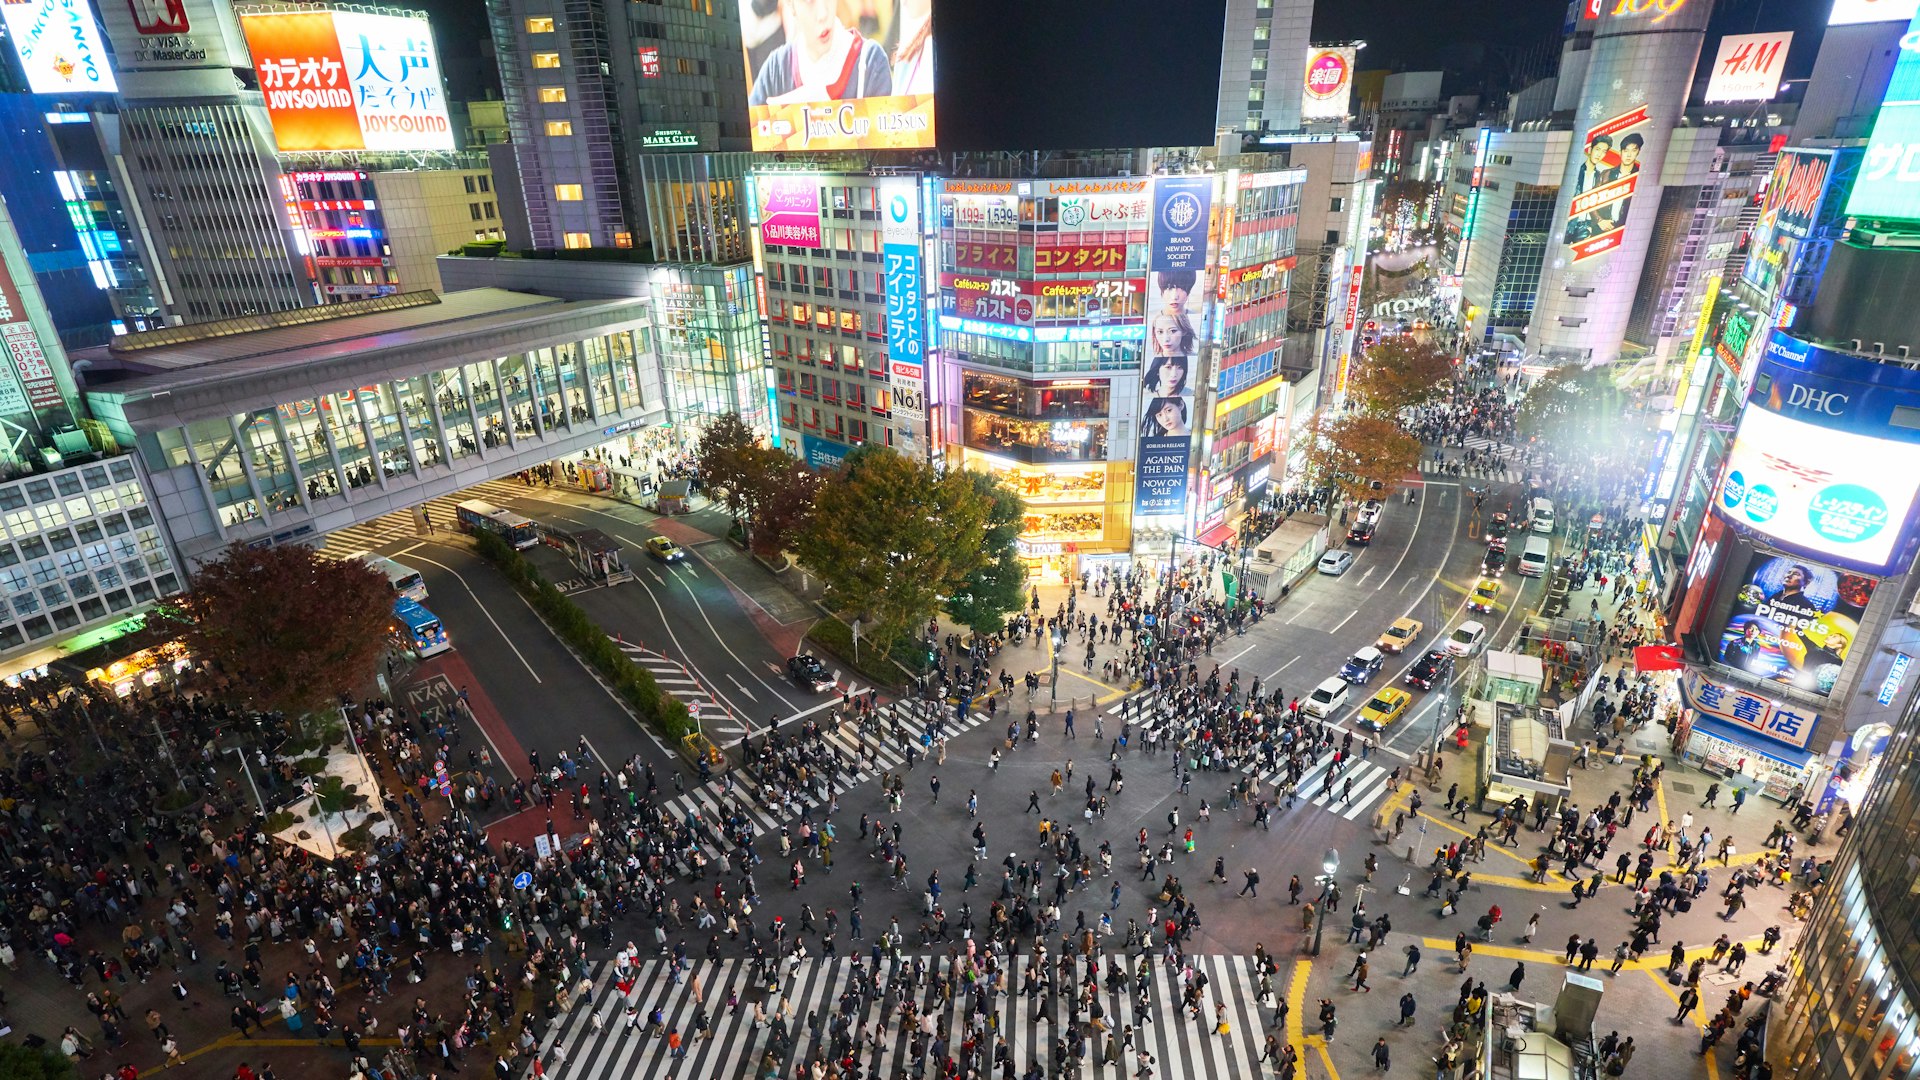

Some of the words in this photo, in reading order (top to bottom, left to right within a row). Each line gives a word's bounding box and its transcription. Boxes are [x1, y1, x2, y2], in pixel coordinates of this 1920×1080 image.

[140, 38, 156, 48] DC
[159, 36, 181, 48] VISA
[134, 52, 150, 62] DC
[153, 49, 206, 60] MasterCard
[346, 33, 430, 83] 大声
[1721, 41, 1783, 76] H&M
[260, 57, 341, 88] カラオケ
[270, 88, 351, 109] JOYSOUND
[355, 85, 441, 110] だそうぜ
[364, 115, 447, 133] JOYSOUND
[803, 108, 837, 146] JAPAN
[838, 105, 869, 135] CUP
[904, 115, 926, 129] SUN
[643, 136, 671, 144] MARK
[672, 135, 698, 143] CITY
[296, 173, 322, 182] カラオケ
[944, 182, 1012, 193] しゃぶしゃぶバイキング
[1049, 181, 1148, 193] しゃぶしゃぶバイキング
[784, 196, 812, 208] クリニック
[1090, 199, 1147, 221] しゃぶ葉
[941, 206, 953, 217] 9F
[769, 225, 818, 242] 品川美容外科
[887, 226, 914, 240] eyecity
[1035, 247, 1124, 267] コンタクト
[990, 280, 1021, 297] ガスト
[1095, 281, 1137, 298] ガスト
[887, 254, 905, 353] アイシティ
[904, 255, 920, 356] コンタクトの
[943, 296, 956, 308] 7F
[976, 298, 1012, 320] ガスト
[6, 325, 29, 334] 全国
[964, 319, 1016, 337] イーオン
[1768, 341, 1779, 355] DHC
[1777, 345, 1807, 363] Channel
[1787, 383, 1849, 417] DHC
[1151, 487, 1172, 496] SALE
[1167, 479, 1182, 487] ON
[1758, 534, 1774, 545] DHC
[1770, 598, 1814, 617] teamLab
[1755, 603, 1829, 635] Planets
[1774, 622, 1805, 637] TOKYO
[1765, 633, 1803, 651] TOYOSU
